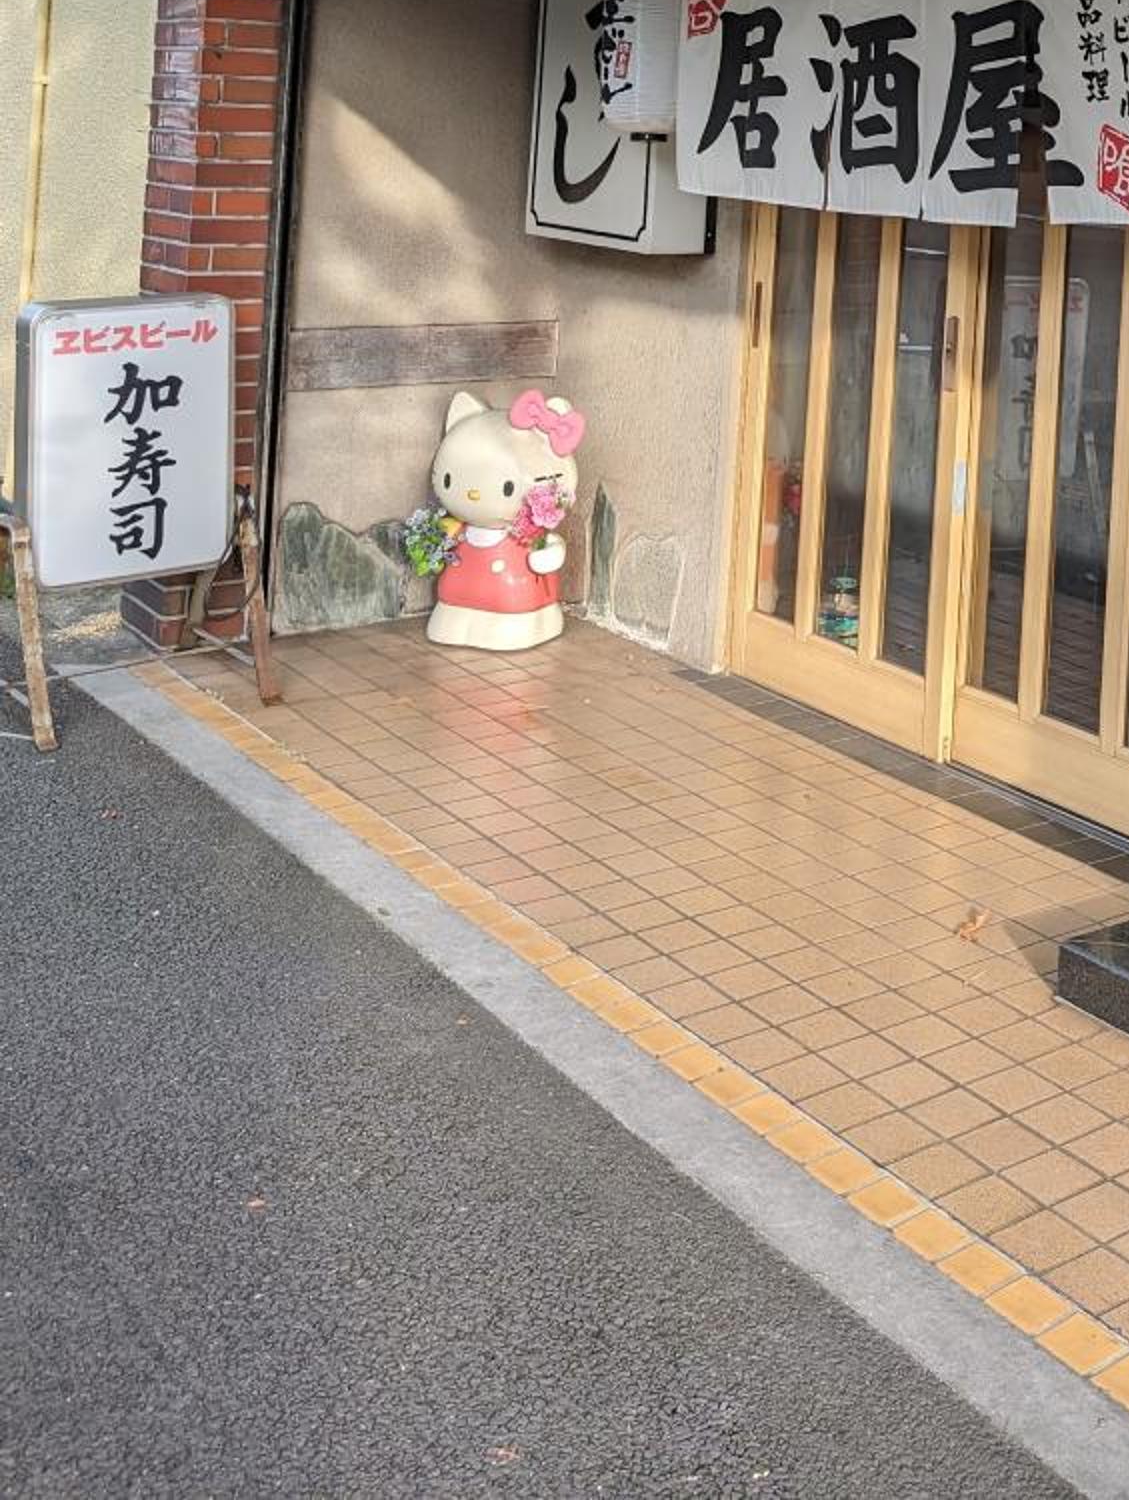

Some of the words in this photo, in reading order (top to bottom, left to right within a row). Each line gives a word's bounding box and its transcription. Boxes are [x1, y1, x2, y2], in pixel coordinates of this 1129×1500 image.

[697, 0, 1085, 193] 居酒屋
[53, 318, 218, 355] ヱビスビール
[104, 362, 184, 561] 加寿司
